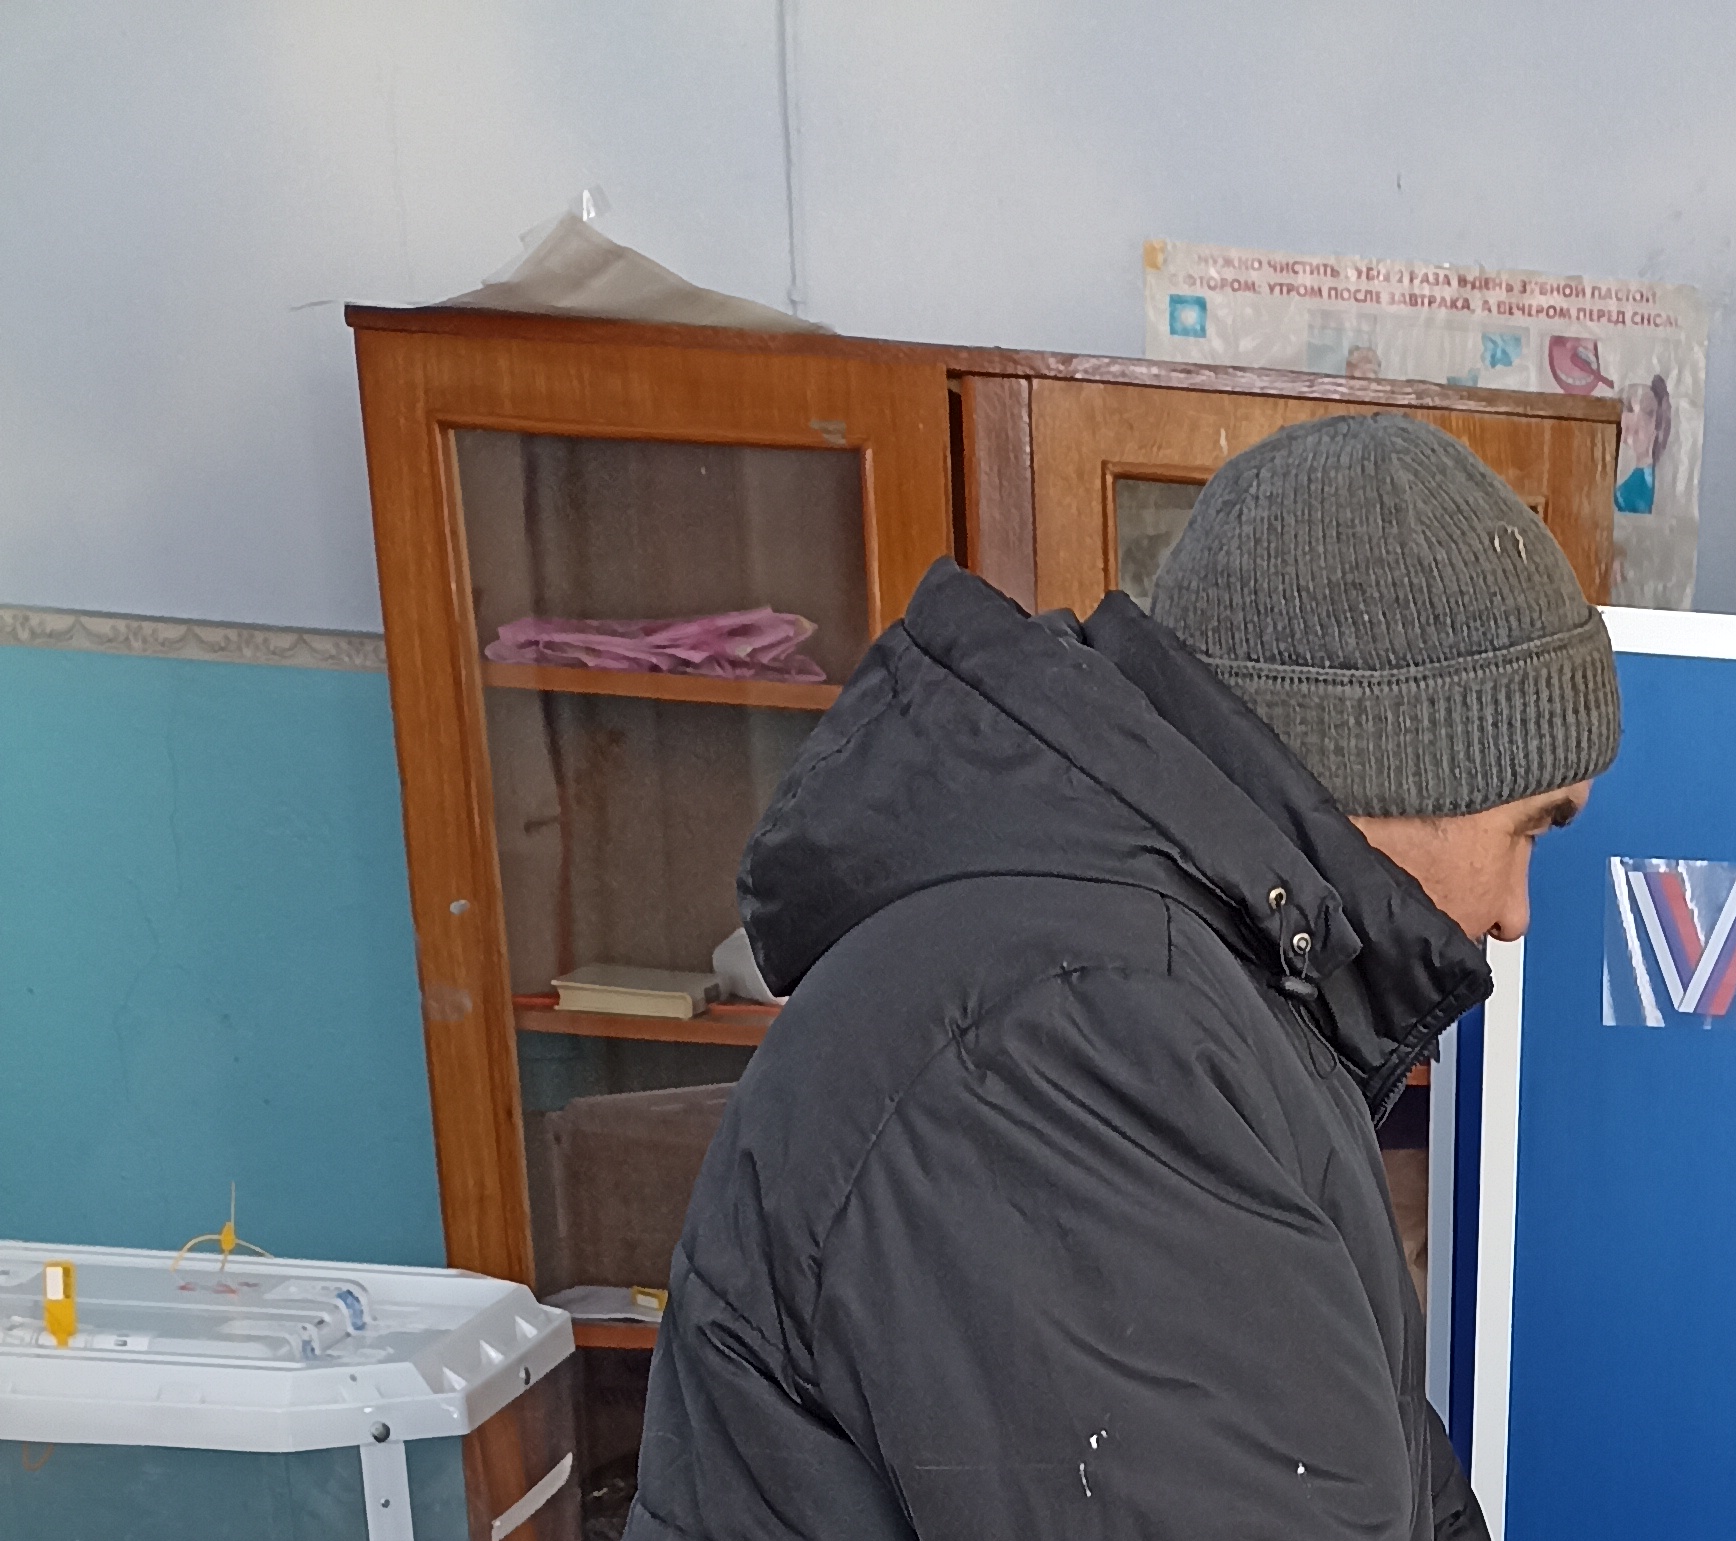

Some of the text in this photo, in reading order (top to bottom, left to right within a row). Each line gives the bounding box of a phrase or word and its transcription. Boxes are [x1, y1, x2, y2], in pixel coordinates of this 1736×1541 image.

[1267, 258, 1341, 279] ЧИСТИТЬ
[1346, 264, 1391, 284] УБЫ
[1409, 269, 1452, 288] РАЗА
[1267, 281, 1324, 300] УТРОМ
[1328, 285, 1382, 305] ПОСЛЕ
[1481, 300, 1492, 314] А
[1496, 301, 1572, 321] ВЕЧЕРОМ
[1575, 306, 1627, 327] ПЕРЕД
